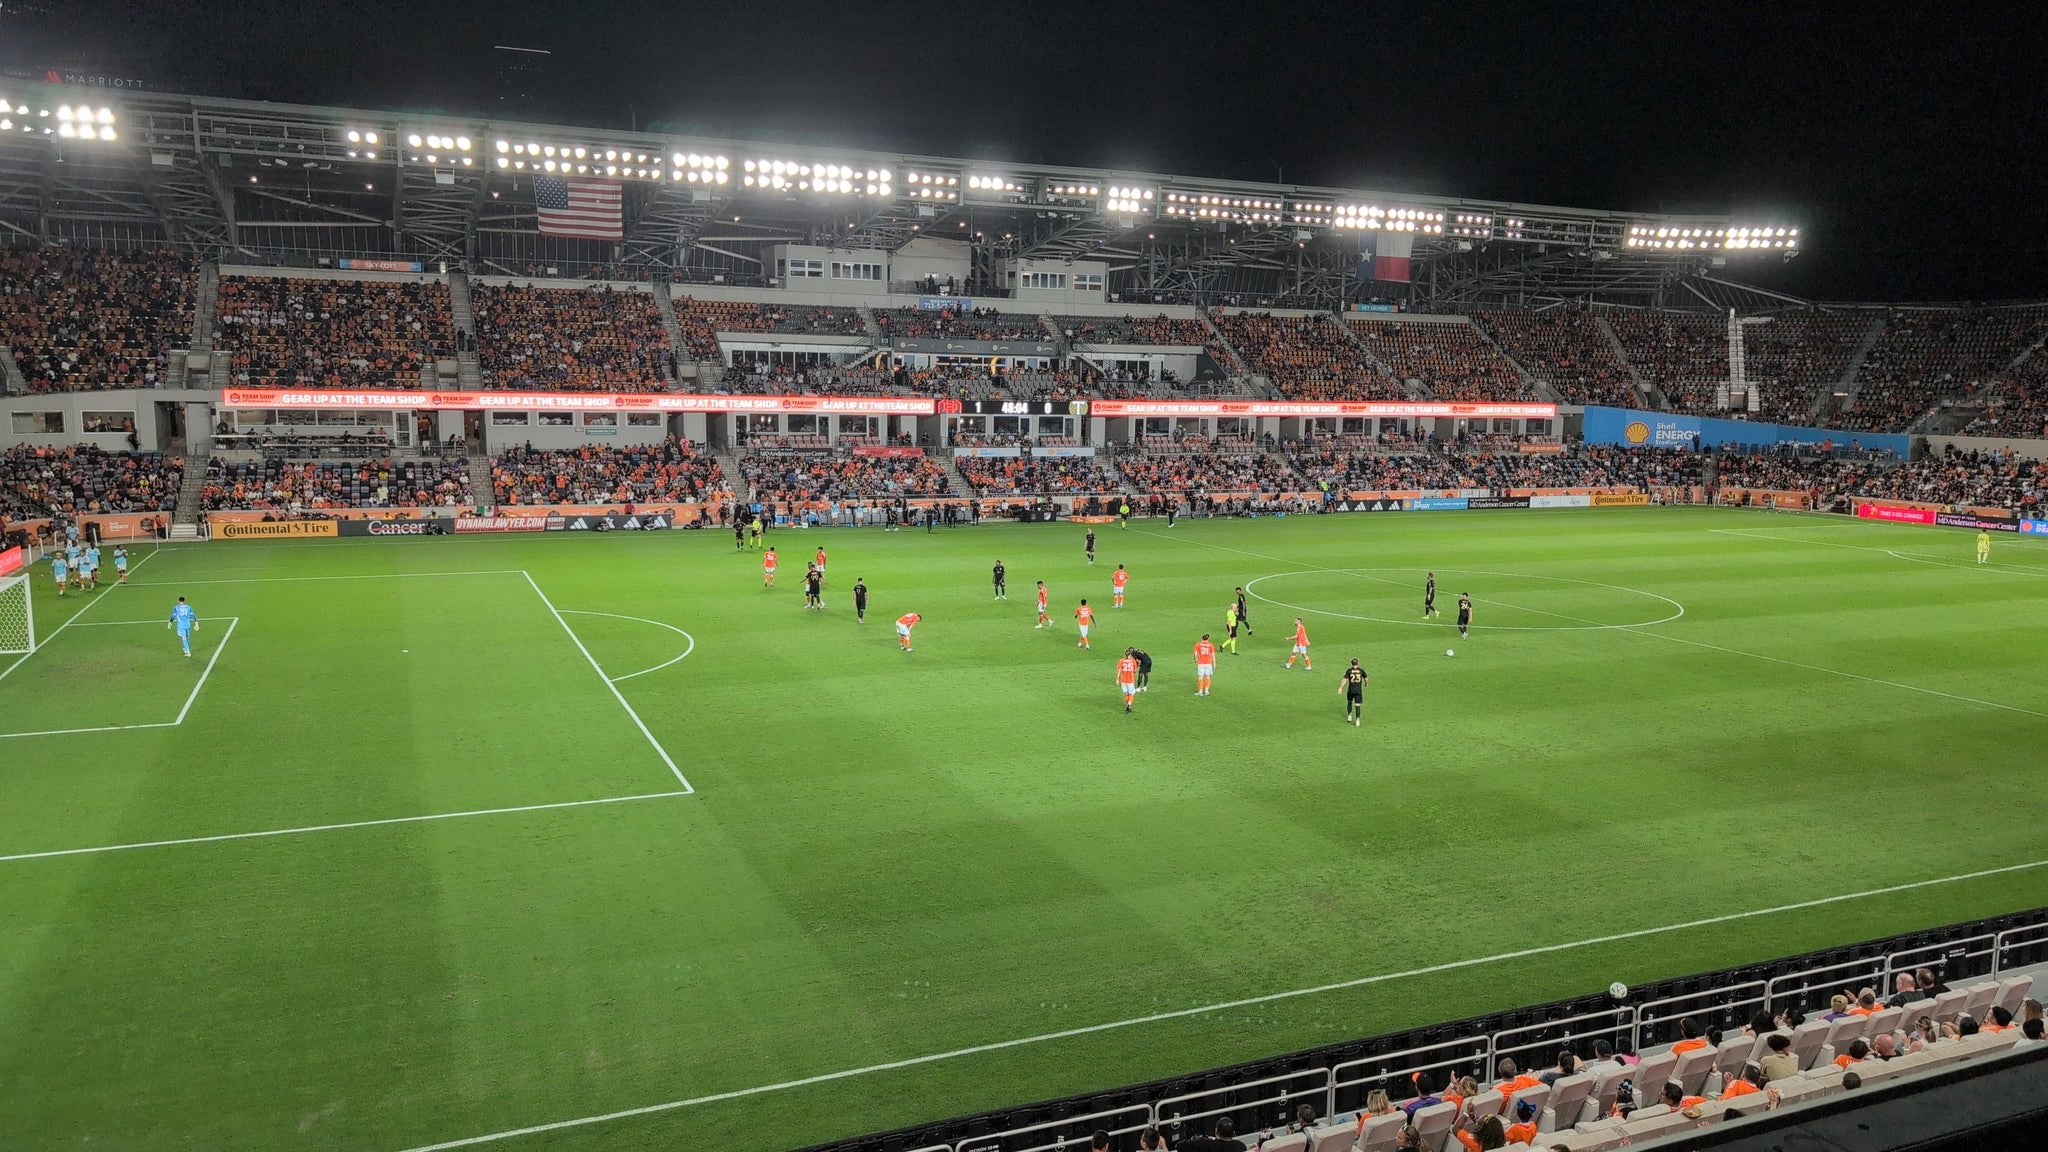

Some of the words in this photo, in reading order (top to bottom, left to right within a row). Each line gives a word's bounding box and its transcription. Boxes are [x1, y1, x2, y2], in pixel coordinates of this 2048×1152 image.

[66, 74, 144, 88] MARRIOTT
[283, 395, 311, 403] GEAR
[314, 395, 328, 403] UP
[329, 395, 343, 403] AT
[345, 396, 365, 404] THE
[366, 396, 395, 404] TEAM
[397, 396, 425, 404] SHOP
[480, 397, 505, 405] GEAR
[507, 397, 520, 405] UP
[522, 398, 534, 406] AT
[536, 398, 554, 406] THE
[557, 398, 582, 406] TEAM
[583, 398, 610, 406] SHOP
[659, 399, 681, 407] GEAR
[683, 399, 694, 407] UP
[695, 399, 707, 407] AT
[708, 400, 726, 408] THE
[728, 400, 752, 408] TEAM
[753, 400, 778, 408] SHOP
[822, 401, 844, 409] GEAR
[846, 401, 857, 409] UP
[858, 401, 869, 409] AT
[870, 402, 886, 410] THE
[887, 402, 908, 410] TEAM
[909, 402, 931, 410] SHOP
[975, 402, 981, 413] 1
[1002, 402, 1028, 414] 48:04
[1045, 402, 1051, 414] 0
[1656, 430, 1700, 440] ENERGY
[1595, 495, 1625, 505] Continental
[1631, 495, 1644, 503] Tire
[368, 520, 426, 535] Cancer
[456, 517, 546, 529] DYNAMOLAWYER.COM
[1949, 518, 1975, 526] Anderson
[1975, 520, 1997, 528] Cancer
[1997, 522, 2017, 531] Center
[223, 523, 290, 537] Continental
[303, 522, 329, 533] Tire
[1201, 647, 1209, 655] 21
[1122, 664, 1133, 672] 25
[1350, 673, 1361, 683] 23
